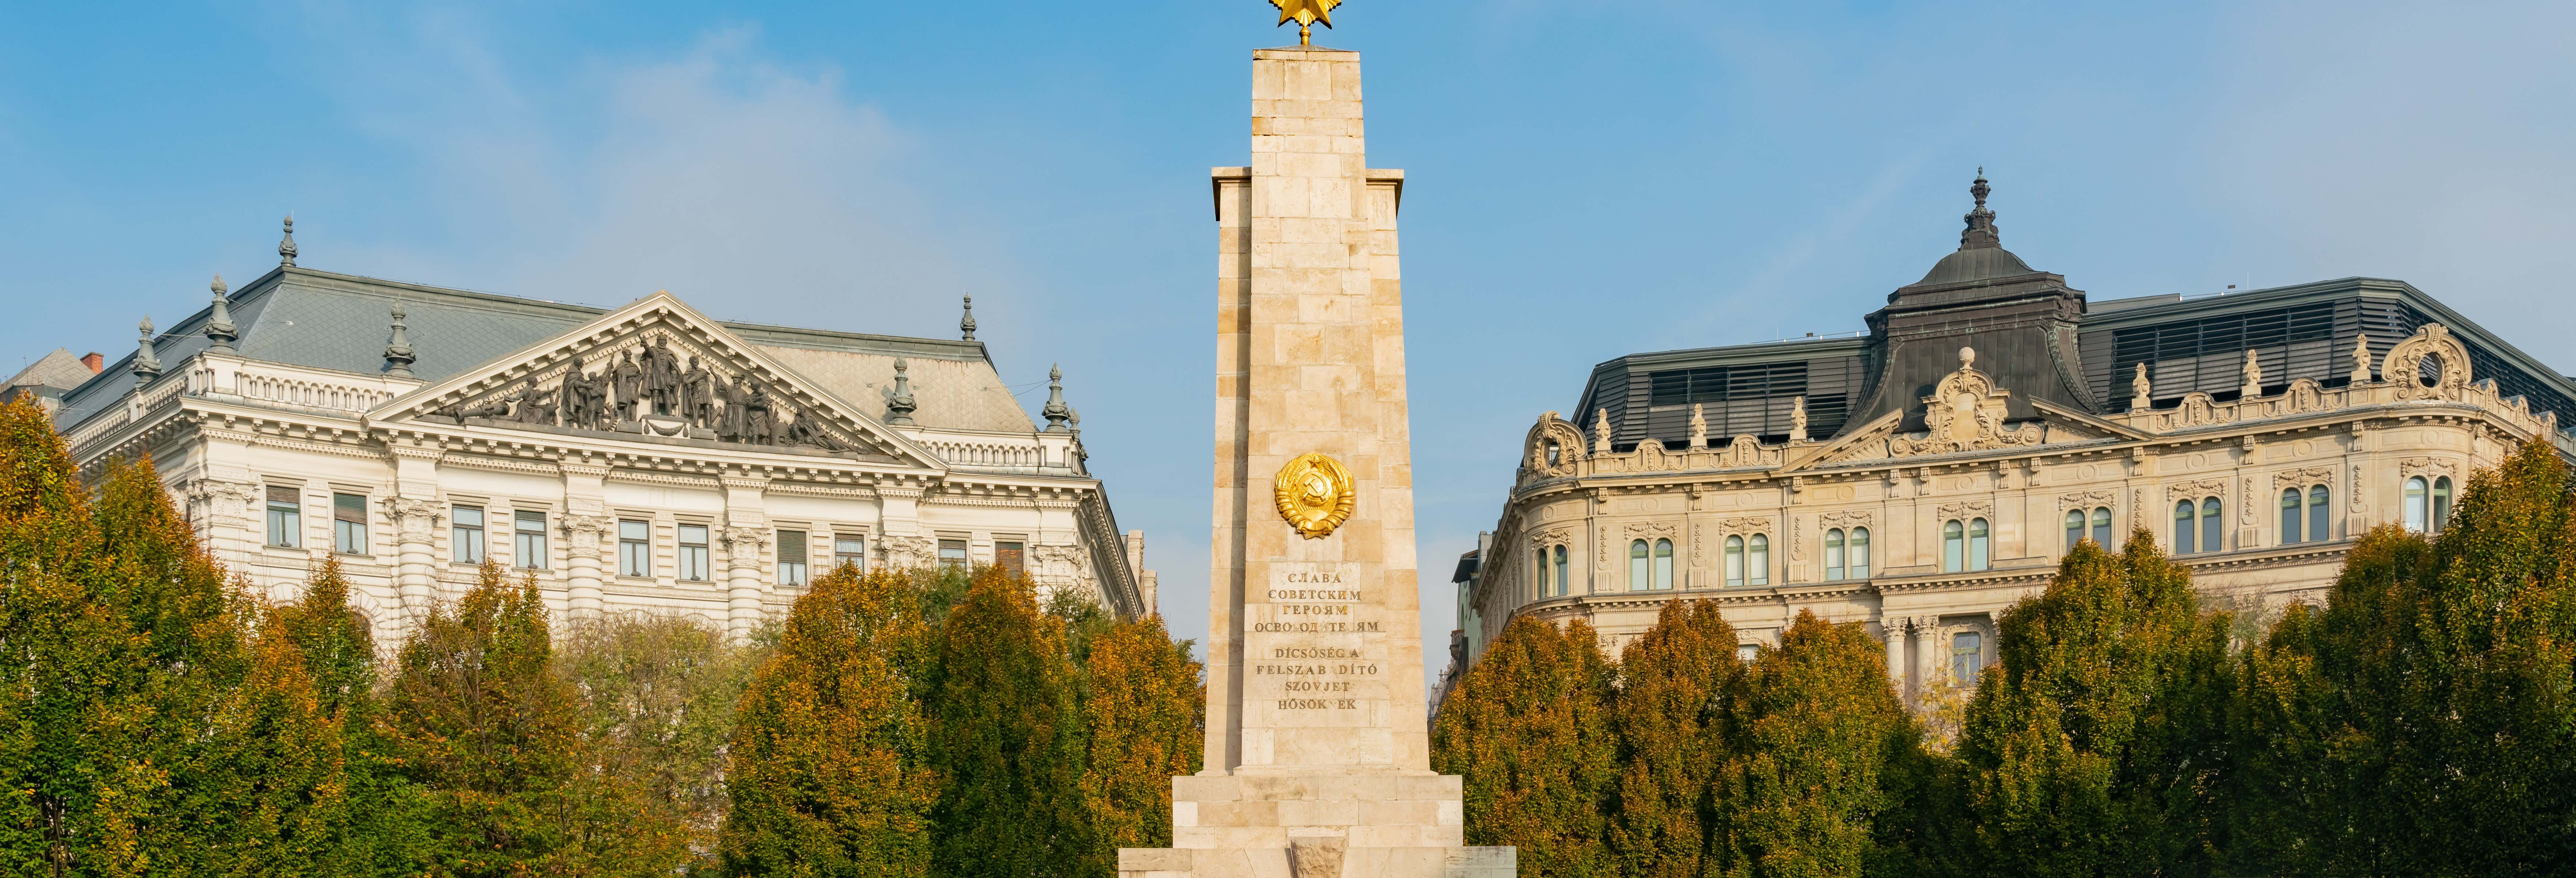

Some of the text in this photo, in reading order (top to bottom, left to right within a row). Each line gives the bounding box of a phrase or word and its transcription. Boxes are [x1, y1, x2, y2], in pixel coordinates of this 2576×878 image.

[1288, 574, 1342, 583] СЛАВА
[1268, 590, 1361, 600] СОВЕТСКИМ
[1282, 605, 1348, 615] ГЕРОЯМ
[1275, 647, 1359, 658] DÍCSŐSÉG A
[1285, 681, 1350, 691] SZOVJET
